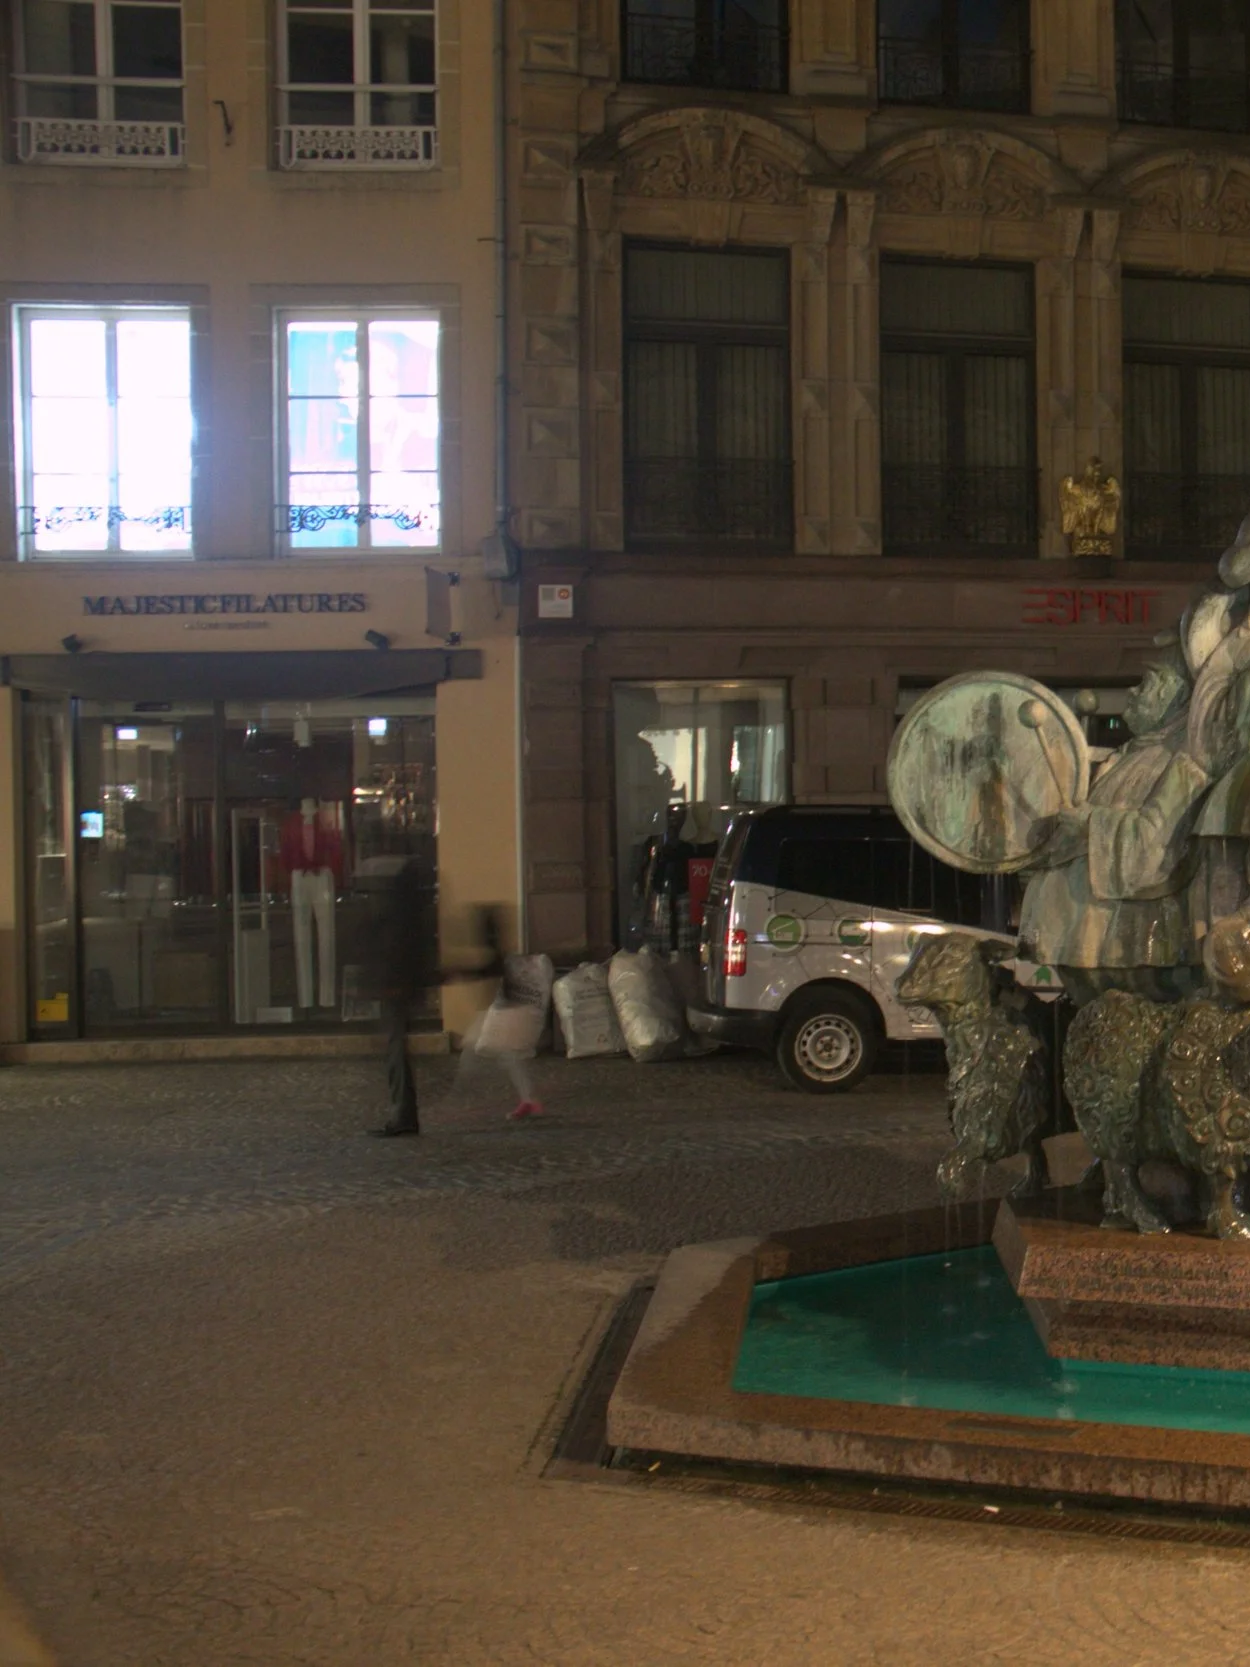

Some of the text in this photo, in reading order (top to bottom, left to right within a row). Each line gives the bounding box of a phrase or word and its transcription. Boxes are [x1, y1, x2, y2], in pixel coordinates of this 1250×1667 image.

[83, 593, 368, 615] MAJESTIC FILATURES
[1021, 587, 1161, 627] ESPRIT
